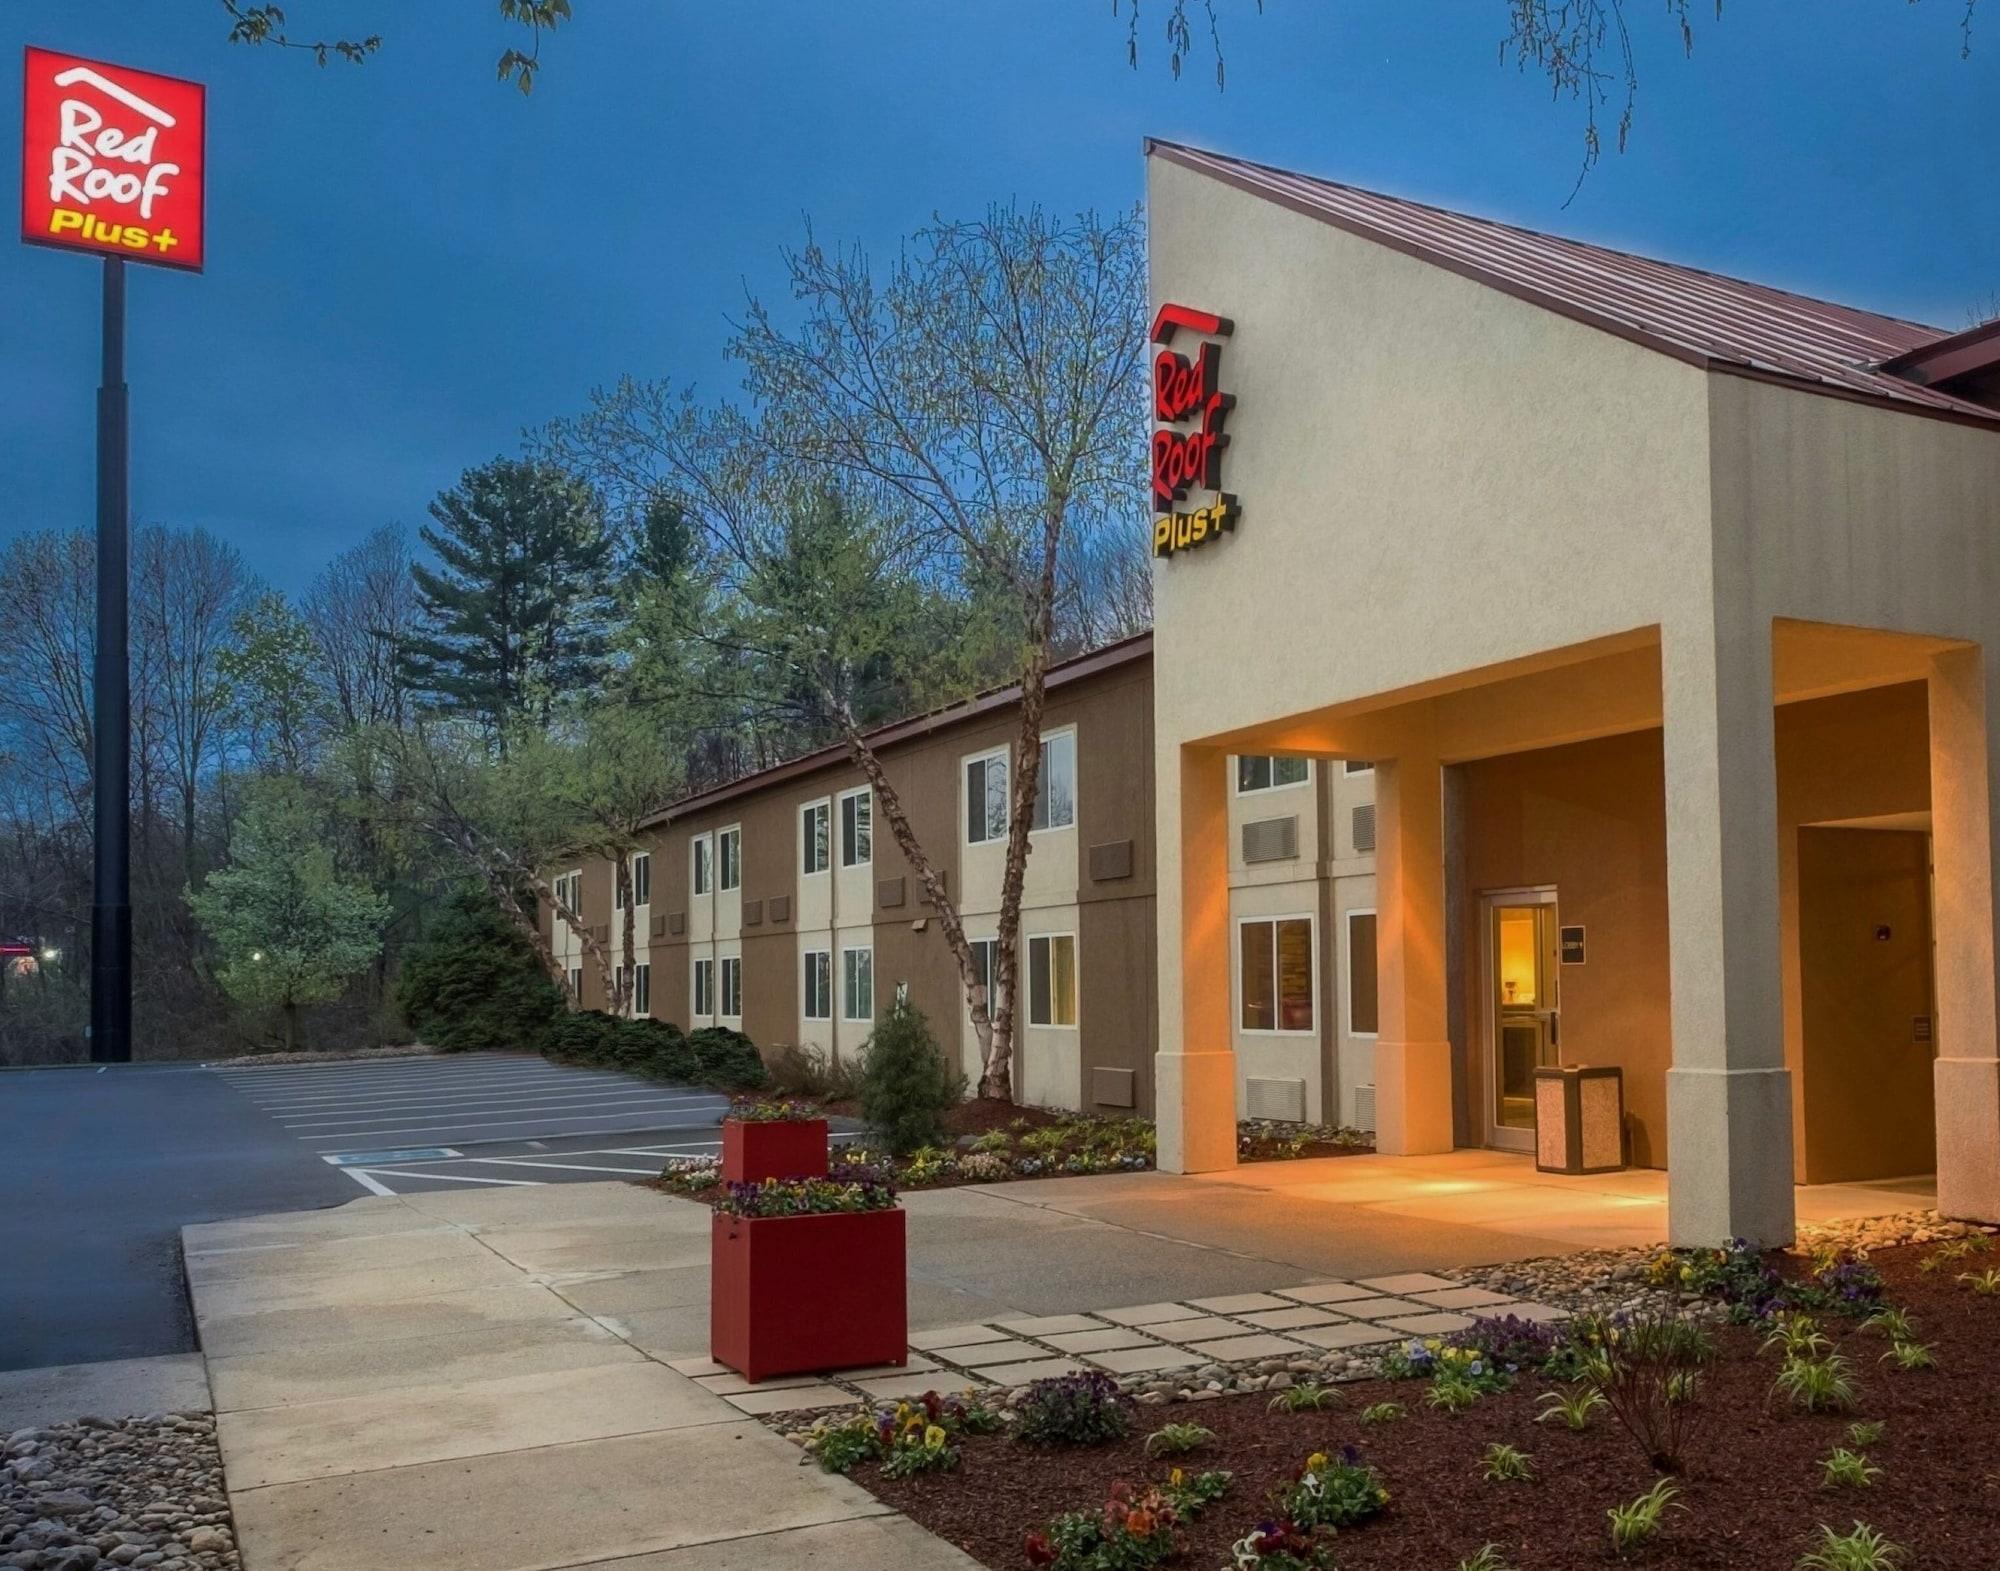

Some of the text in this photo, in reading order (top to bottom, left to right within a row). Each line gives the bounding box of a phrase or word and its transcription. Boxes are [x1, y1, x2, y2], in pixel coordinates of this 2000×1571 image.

[61, 99, 158, 165] Red
[49, 146, 181, 219] Roof
[50, 208, 178, 252] Plus+
[1155, 341, 1212, 422] Red
[1152, 391, 1228, 510] Roof
[1153, 492, 1231, 558] Plus+
